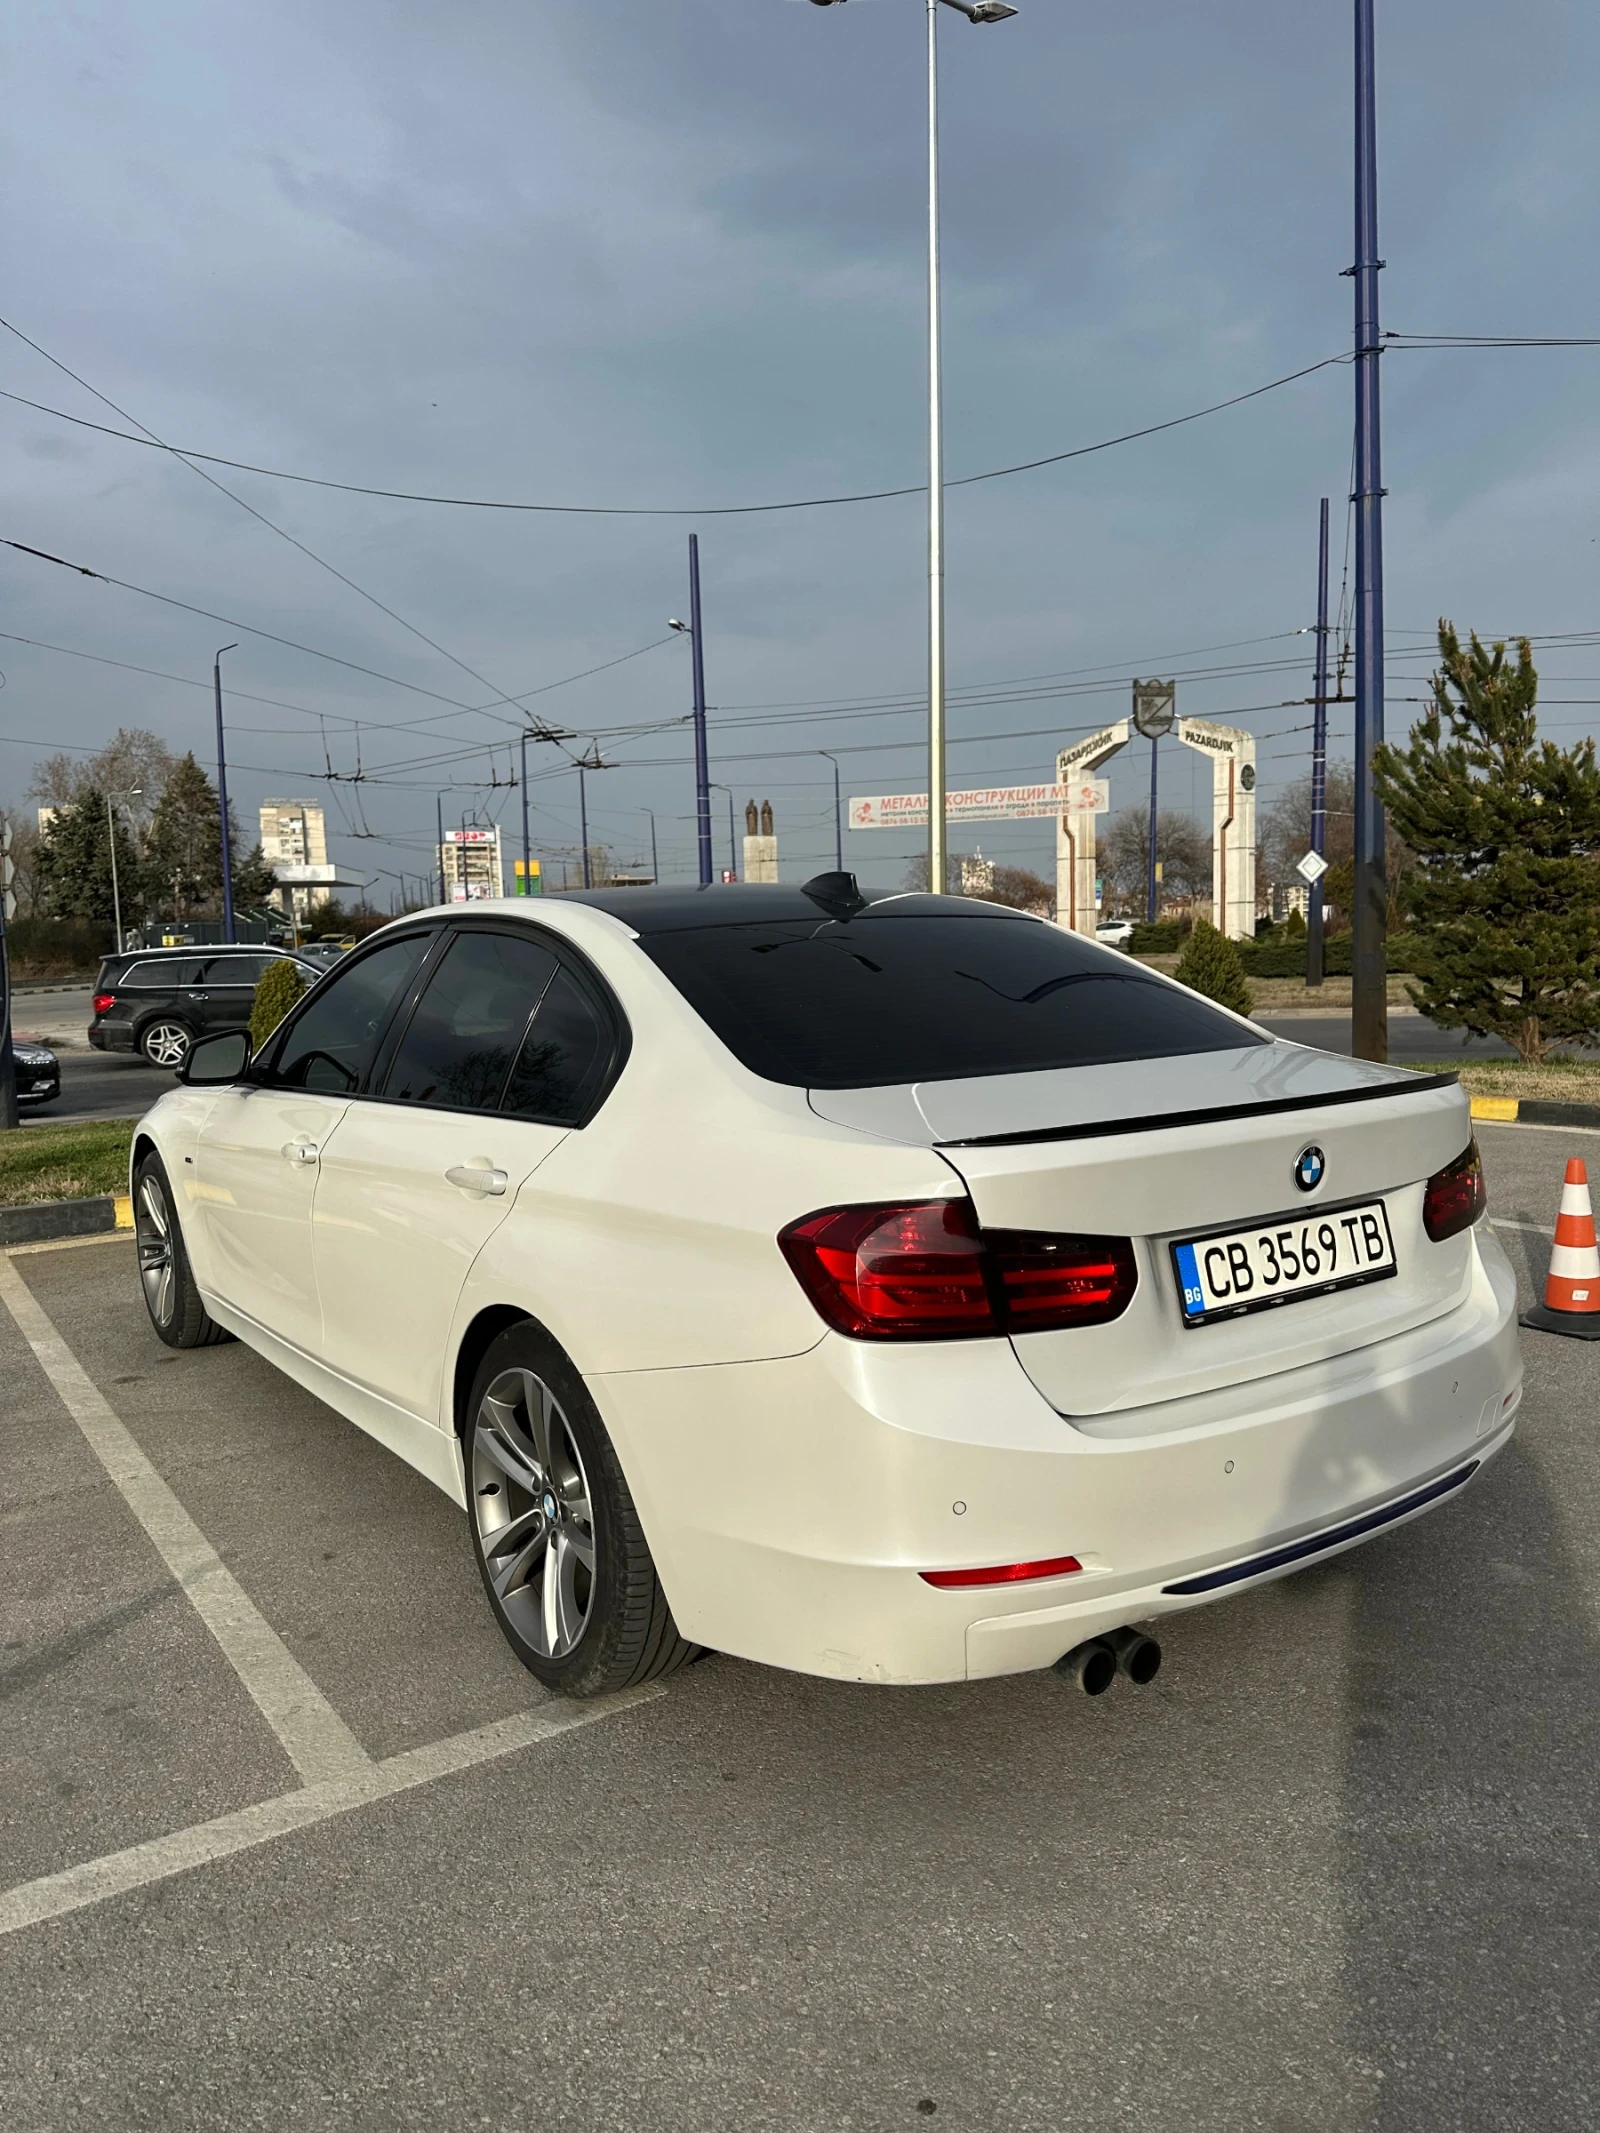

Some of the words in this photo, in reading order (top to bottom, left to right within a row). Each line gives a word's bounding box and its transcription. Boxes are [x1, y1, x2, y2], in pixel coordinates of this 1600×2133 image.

[1059, 731, 1113, 768] ПАЗАРДЖИК
[1186, 731, 1233, 753] PAZARDJIK
[881, 796, 928, 810] МЕТАЛН
[945, 787, 1046, 806] КОНСТРУКЦИИ
[1050, 785, 1070, 799] МТ
[1005, 802, 1030, 810] огради
[1204, 1242, 1254, 1298] CB
[1258, 1223, 1337, 1286] 3569
[1340, 1213, 1384, 1265] TB
[1184, 1287, 1202, 1305] BG
